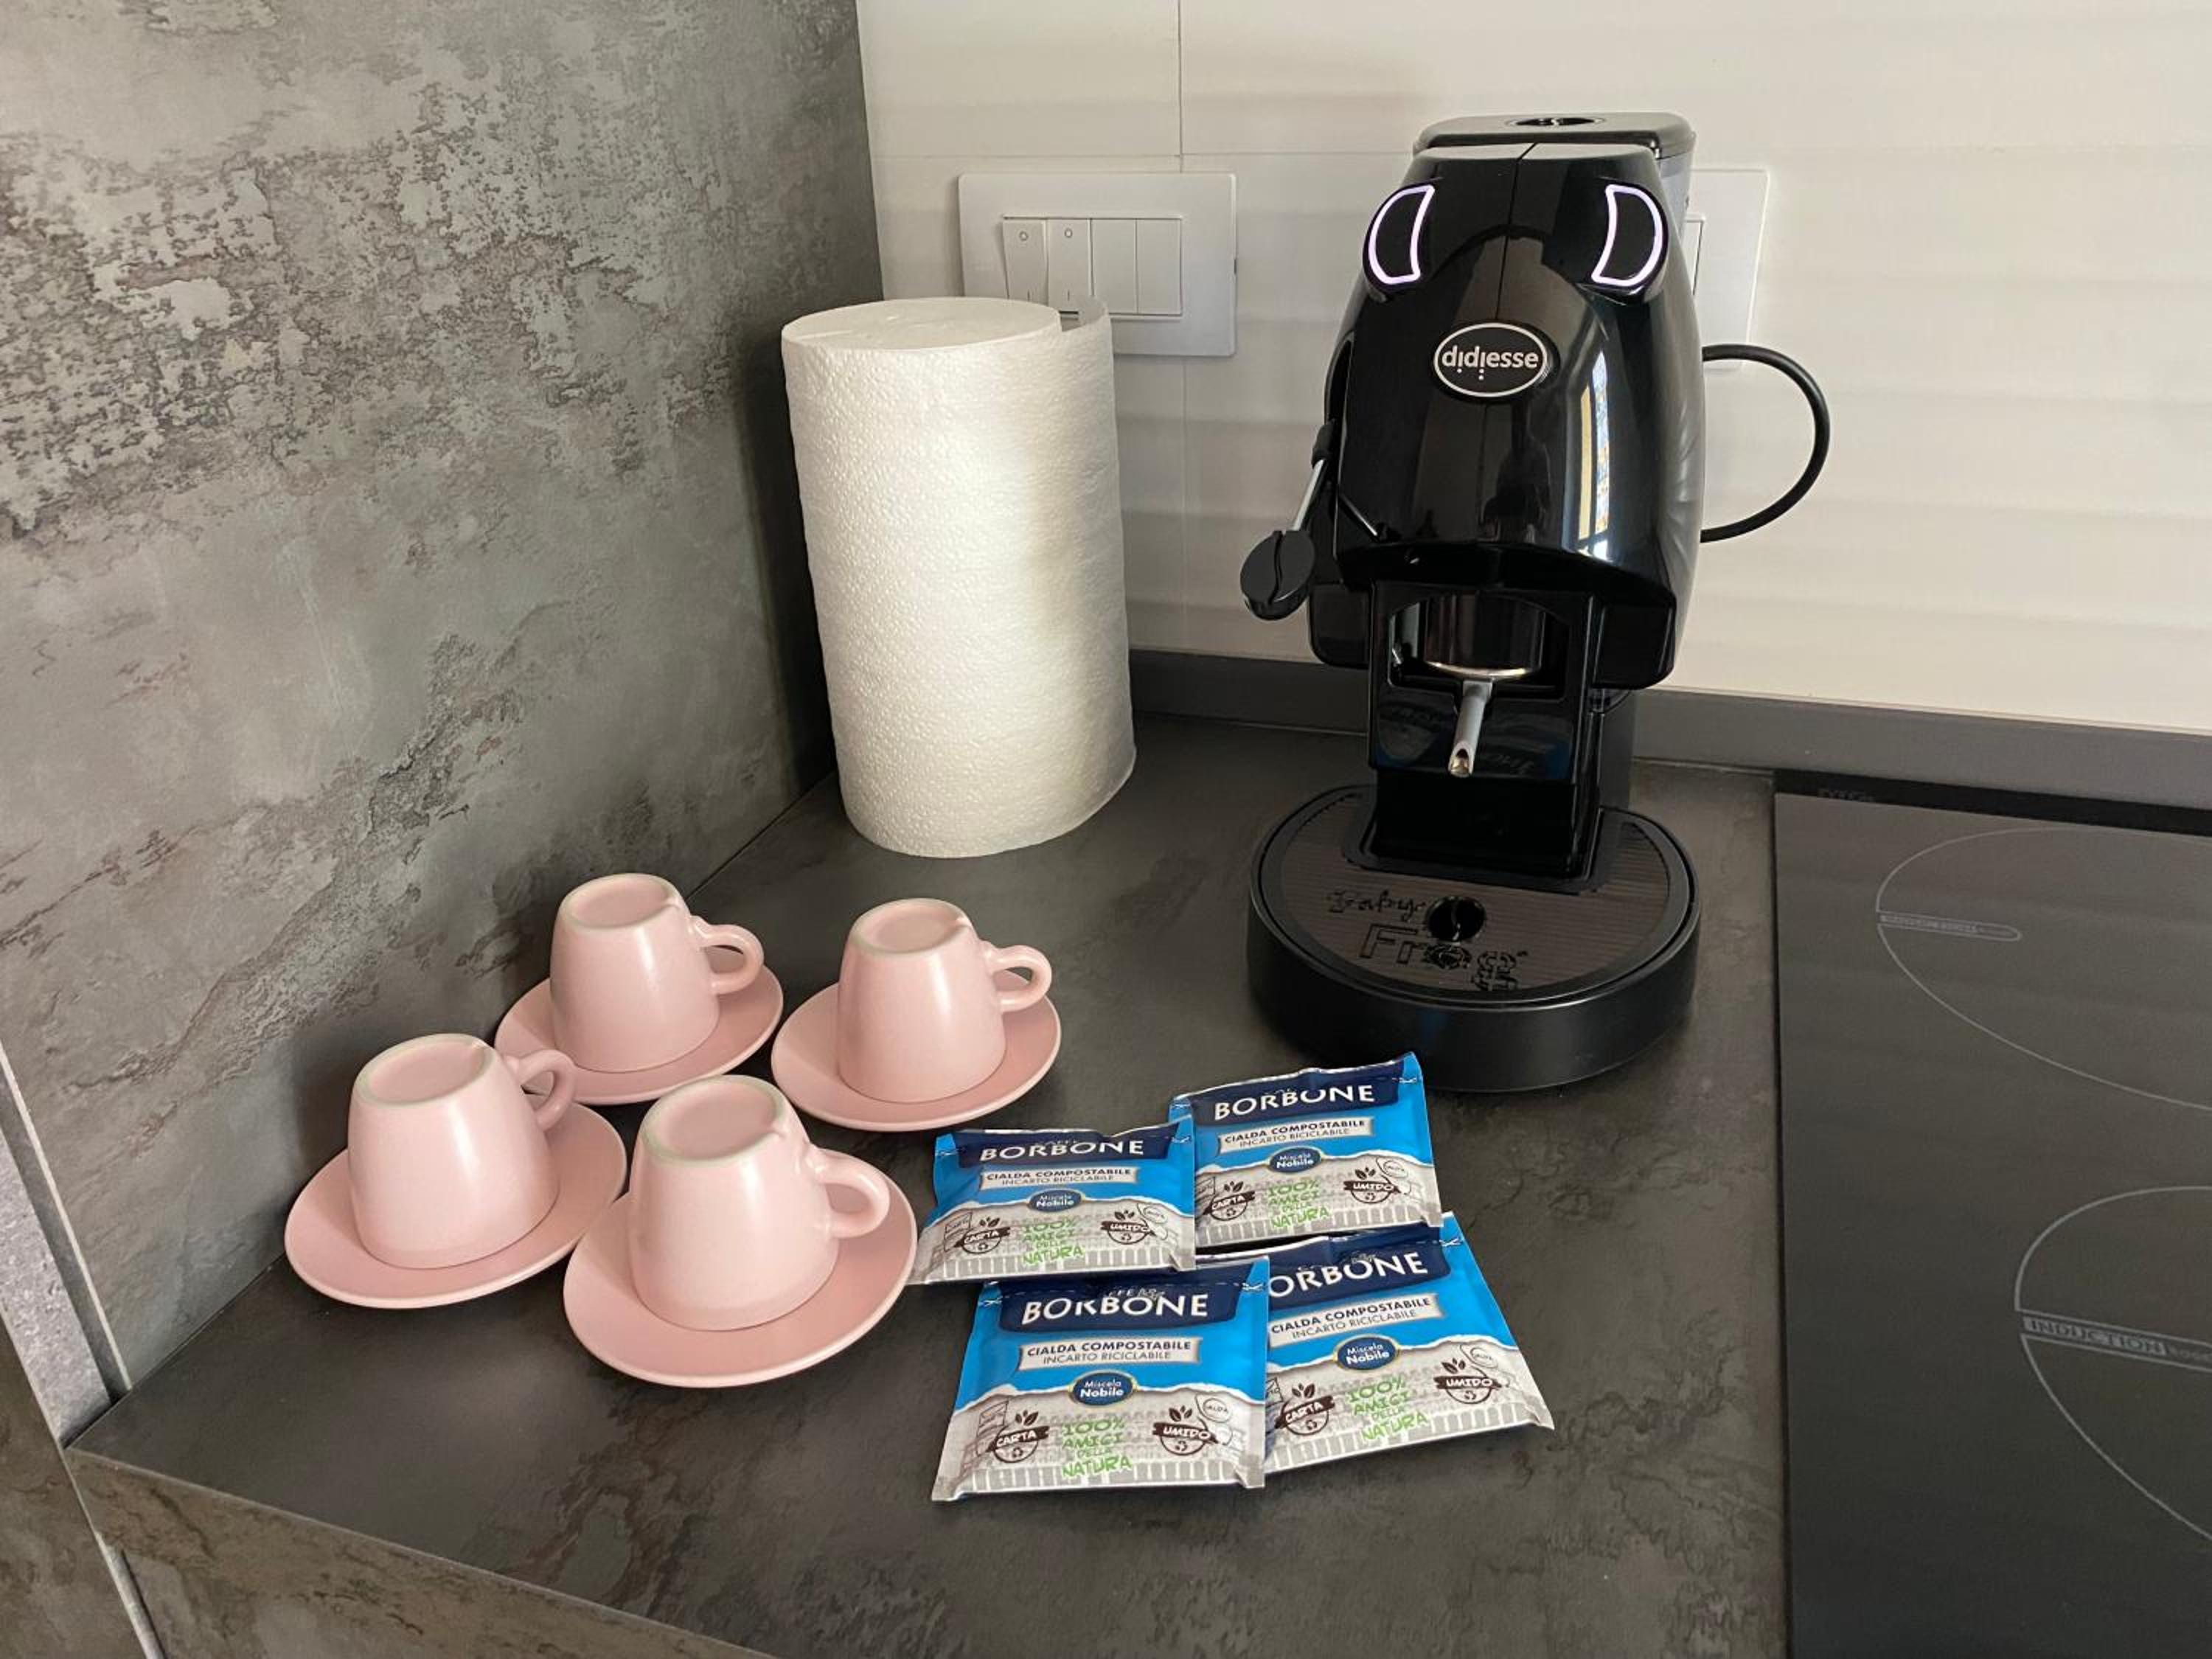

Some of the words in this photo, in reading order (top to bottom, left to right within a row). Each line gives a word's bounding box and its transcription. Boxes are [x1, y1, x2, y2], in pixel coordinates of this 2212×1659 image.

[1441, 344, 1539, 380] didiesse
[1214, 1085, 1375, 1120] BORBONE
[1225, 1130, 1266, 1143] CIALDA
[1271, 1120, 1364, 1135] COMPOSTABILE
[1239, 1135, 1286, 1147] INCARTO
[1290, 1128, 1350, 1139] RICICLABILE
[980, 1141, 1143, 1161] BORBONE
[1276, 1158, 1313, 1168] Nobile
[987, 1172, 1030, 1180] CIALDA
[1035, 1169, 1130, 1178] COMPOSTABILE
[1353, 1183, 1394, 1191] UMIDO
[1036, 1199, 1074, 1207] Nobile
[1211, 1195, 1245, 1210] CARTA
[1272, 1207, 1329, 1227] NATURA
[964, 1231, 999, 1244] CARTA
[1023, 1246, 1082, 1263] NATURA
[1268, 1252, 1428, 1298] ORBONE
[1022, 1294, 1208, 1325] BORBONE
[1271, 1318, 1321, 1333] CIALDA
[1325, 1298, 1431, 1321] COMPOSTABILE
[1291, 1322, 1346, 1339] INCARTO
[1349, 1310, 1416, 1327] RICICLABILE
[1027, 1344, 1076, 1356] CIALDA
[1082, 1341, 1191, 1351] COMPOSTABILE
[1347, 1343, 1384, 1355] Miscela
[1043, 1352, 1098, 1364] INCARTO
[1102, 1352, 1172, 1360] RICICLABILE
[1346, 1351, 1390, 1364] Nobile
[1084, 1379, 1121, 1388] Miscela
[1346, 1376, 1405, 1402] 100%
[1446, 1378, 1492, 1387] UMIDO
[1080, 1386, 1124, 1398] Nobile
[1285, 1402, 1324, 1422] CARTA
[1354, 1391, 1411, 1416] AMICI
[1063, 1417, 1124, 1435] 100%
[1163, 1426, 1211, 1439] UMIDO
[1363, 1411, 1427, 1440] NATURA
[996, 1430, 1037, 1447] CARTA
[1062, 1433, 1123, 1449] AMICI
[1062, 1456, 1132, 1477] NATURA
